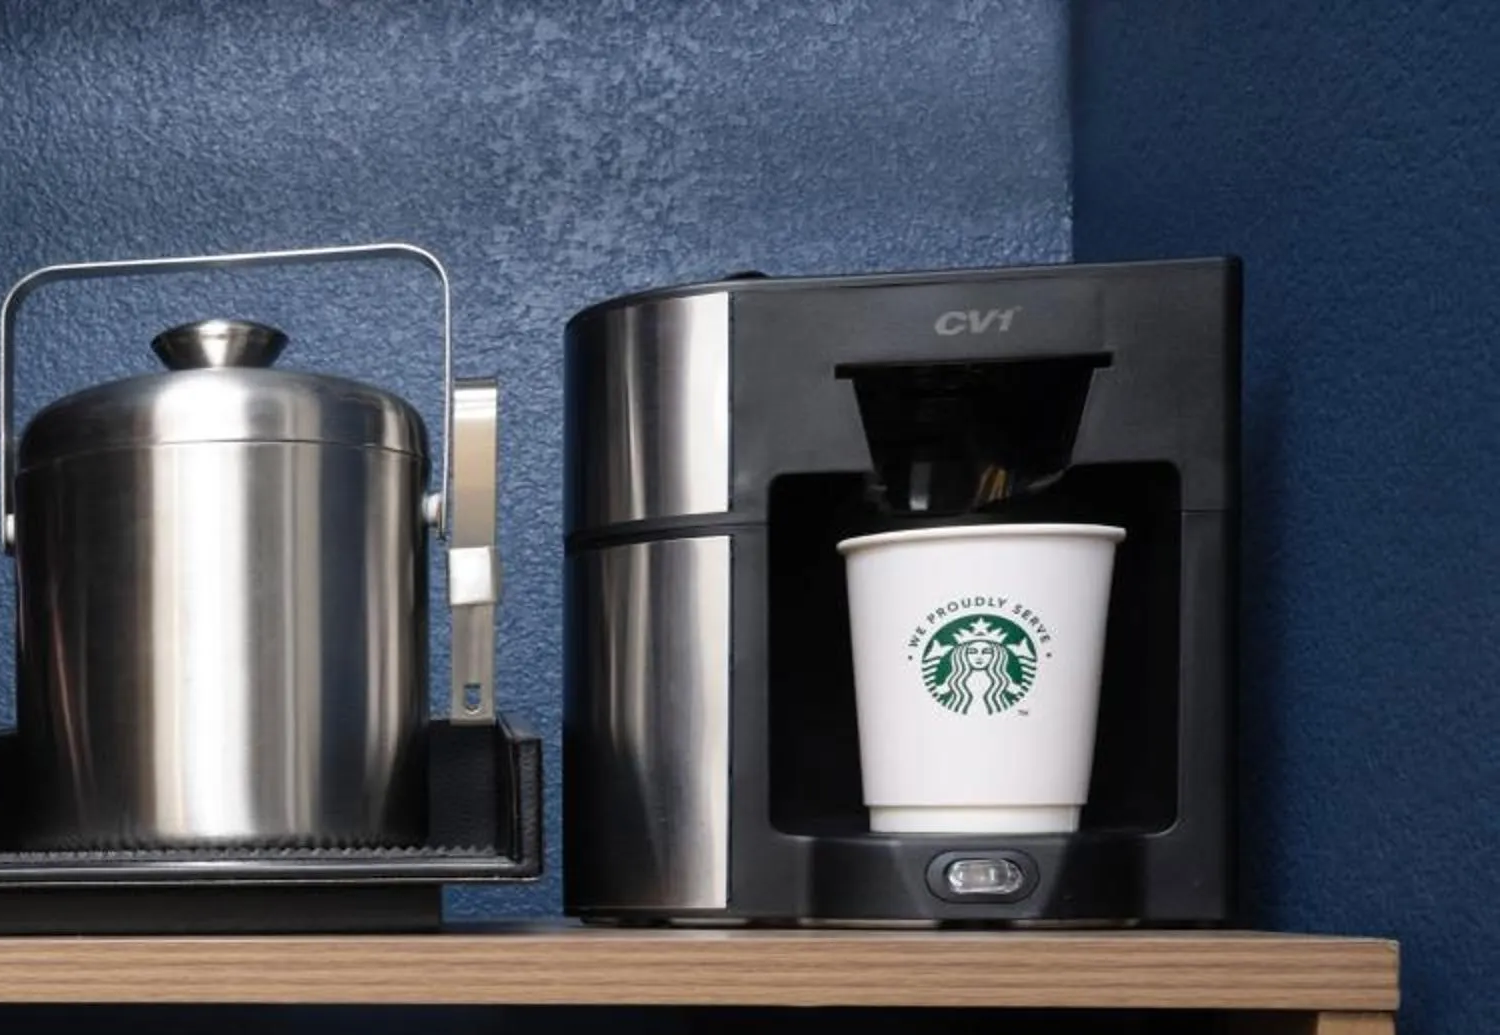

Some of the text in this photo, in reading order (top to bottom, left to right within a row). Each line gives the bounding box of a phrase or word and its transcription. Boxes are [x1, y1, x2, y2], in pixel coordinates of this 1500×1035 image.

[907, 596, 1051, 648] WE PROUDLY SERVE
